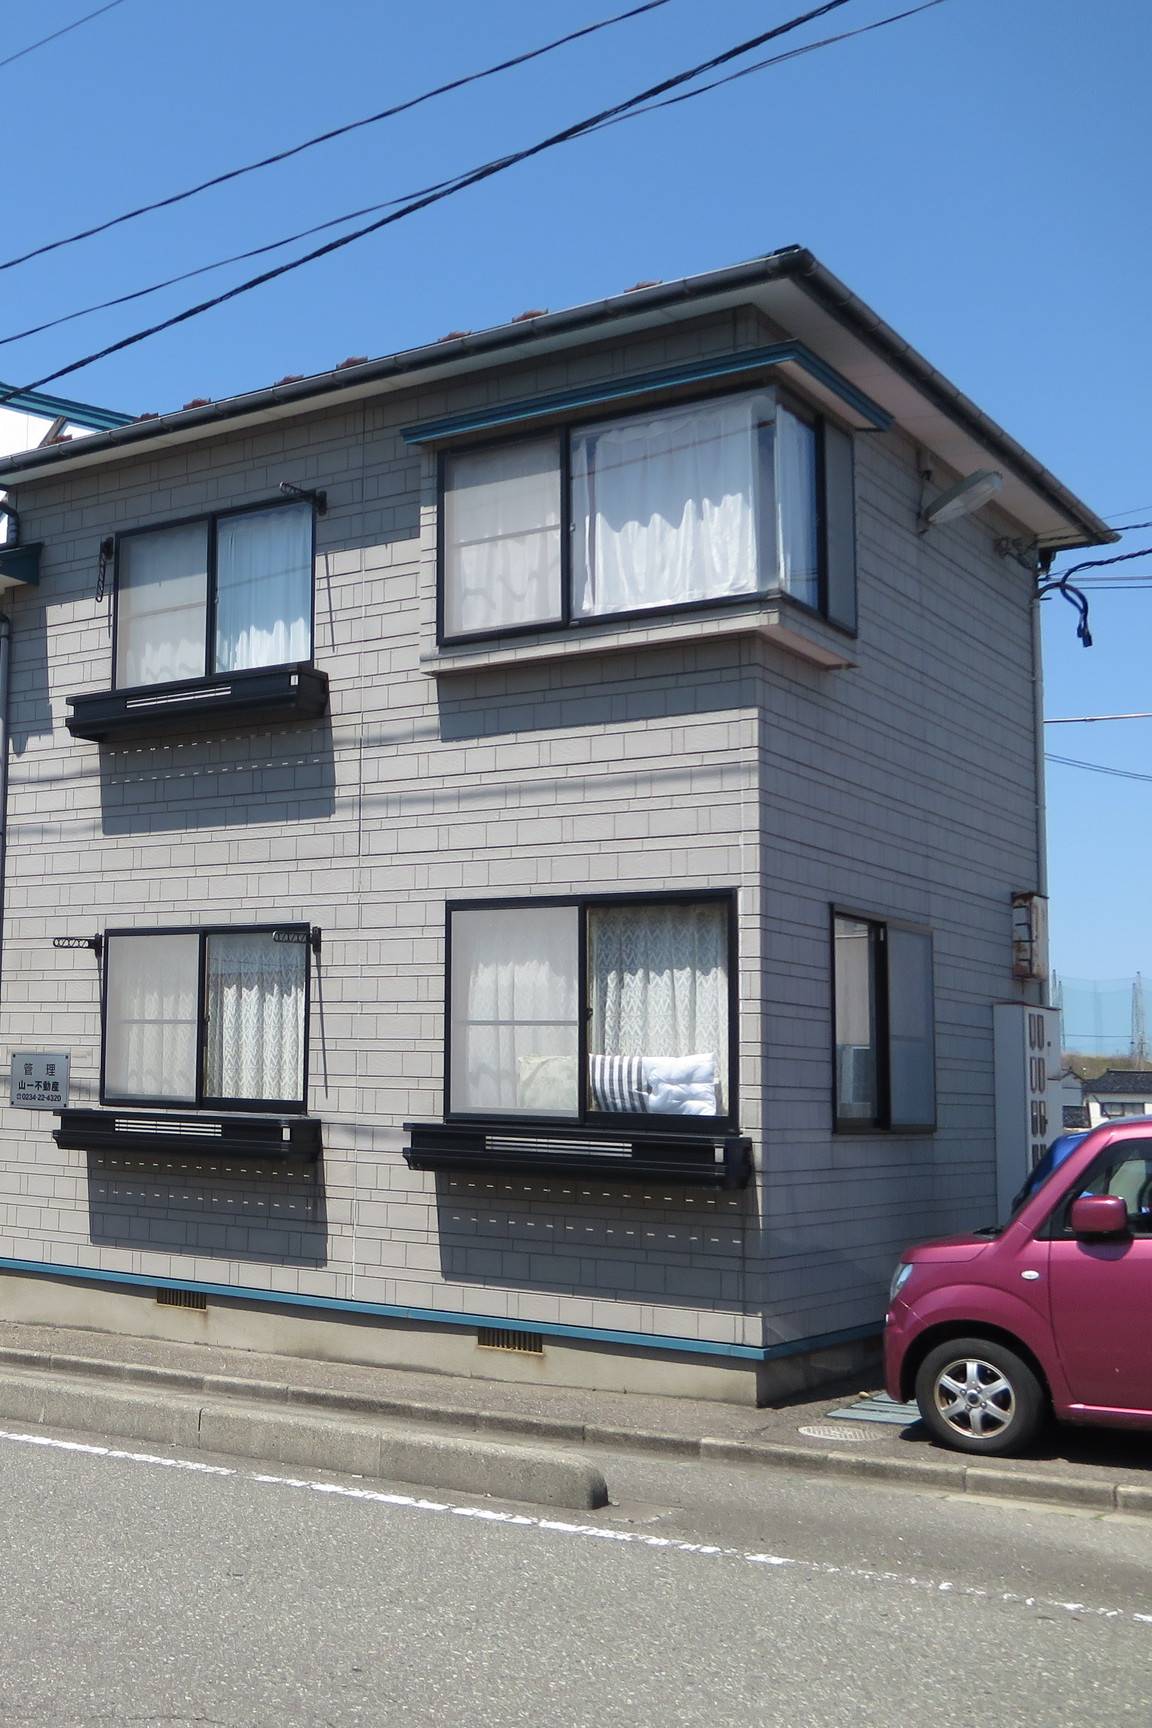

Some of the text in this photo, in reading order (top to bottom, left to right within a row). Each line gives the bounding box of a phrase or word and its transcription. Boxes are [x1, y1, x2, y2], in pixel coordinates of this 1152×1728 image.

[18, 1080, 60, 1092] 山一不動産
